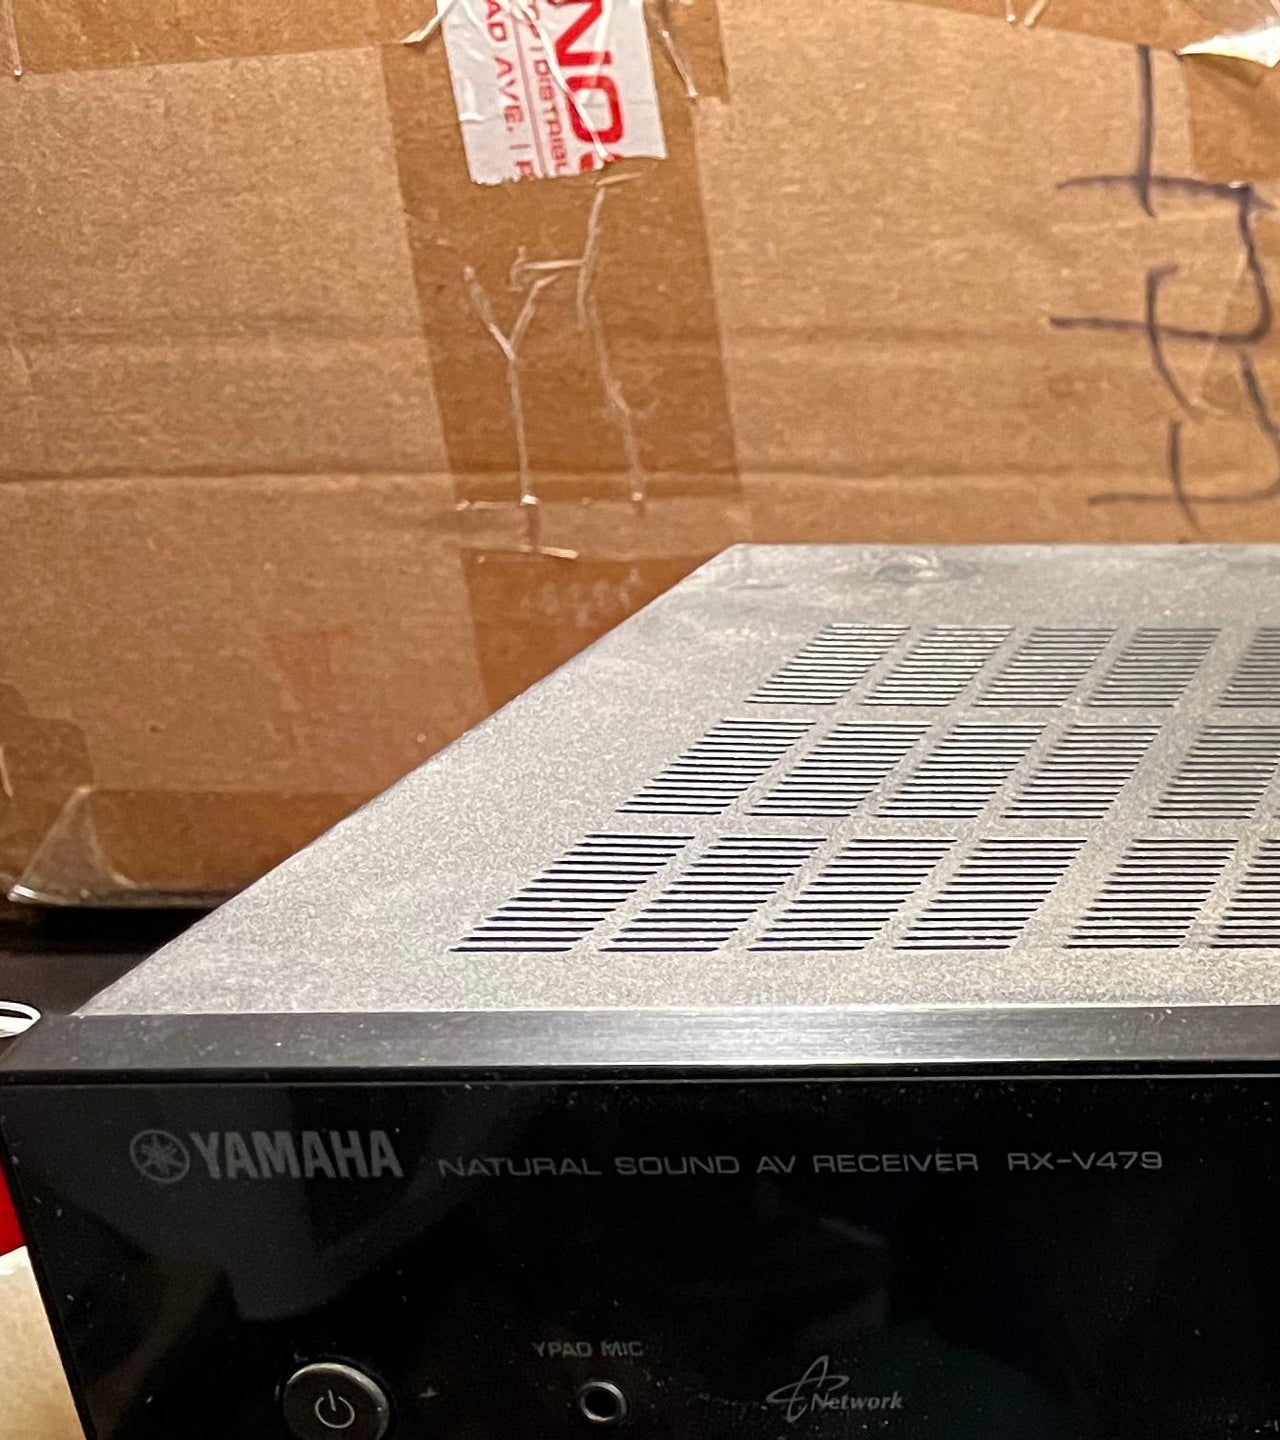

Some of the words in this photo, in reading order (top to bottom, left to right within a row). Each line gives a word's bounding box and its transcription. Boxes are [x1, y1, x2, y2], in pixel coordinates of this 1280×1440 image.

[189, 1130, 404, 1181] YAMAHA
[438, 1156, 603, 1177] NATURAL
[615, 1155, 740, 1176] SOUND
[756, 1155, 796, 1174] AV
[813, 1153, 978, 1174] RECEIVER
[1007, 1151, 1163, 1173] RX-V479
[601, 1341, 644, 1357] MIC
[810, 1390, 904, 1412] Network
